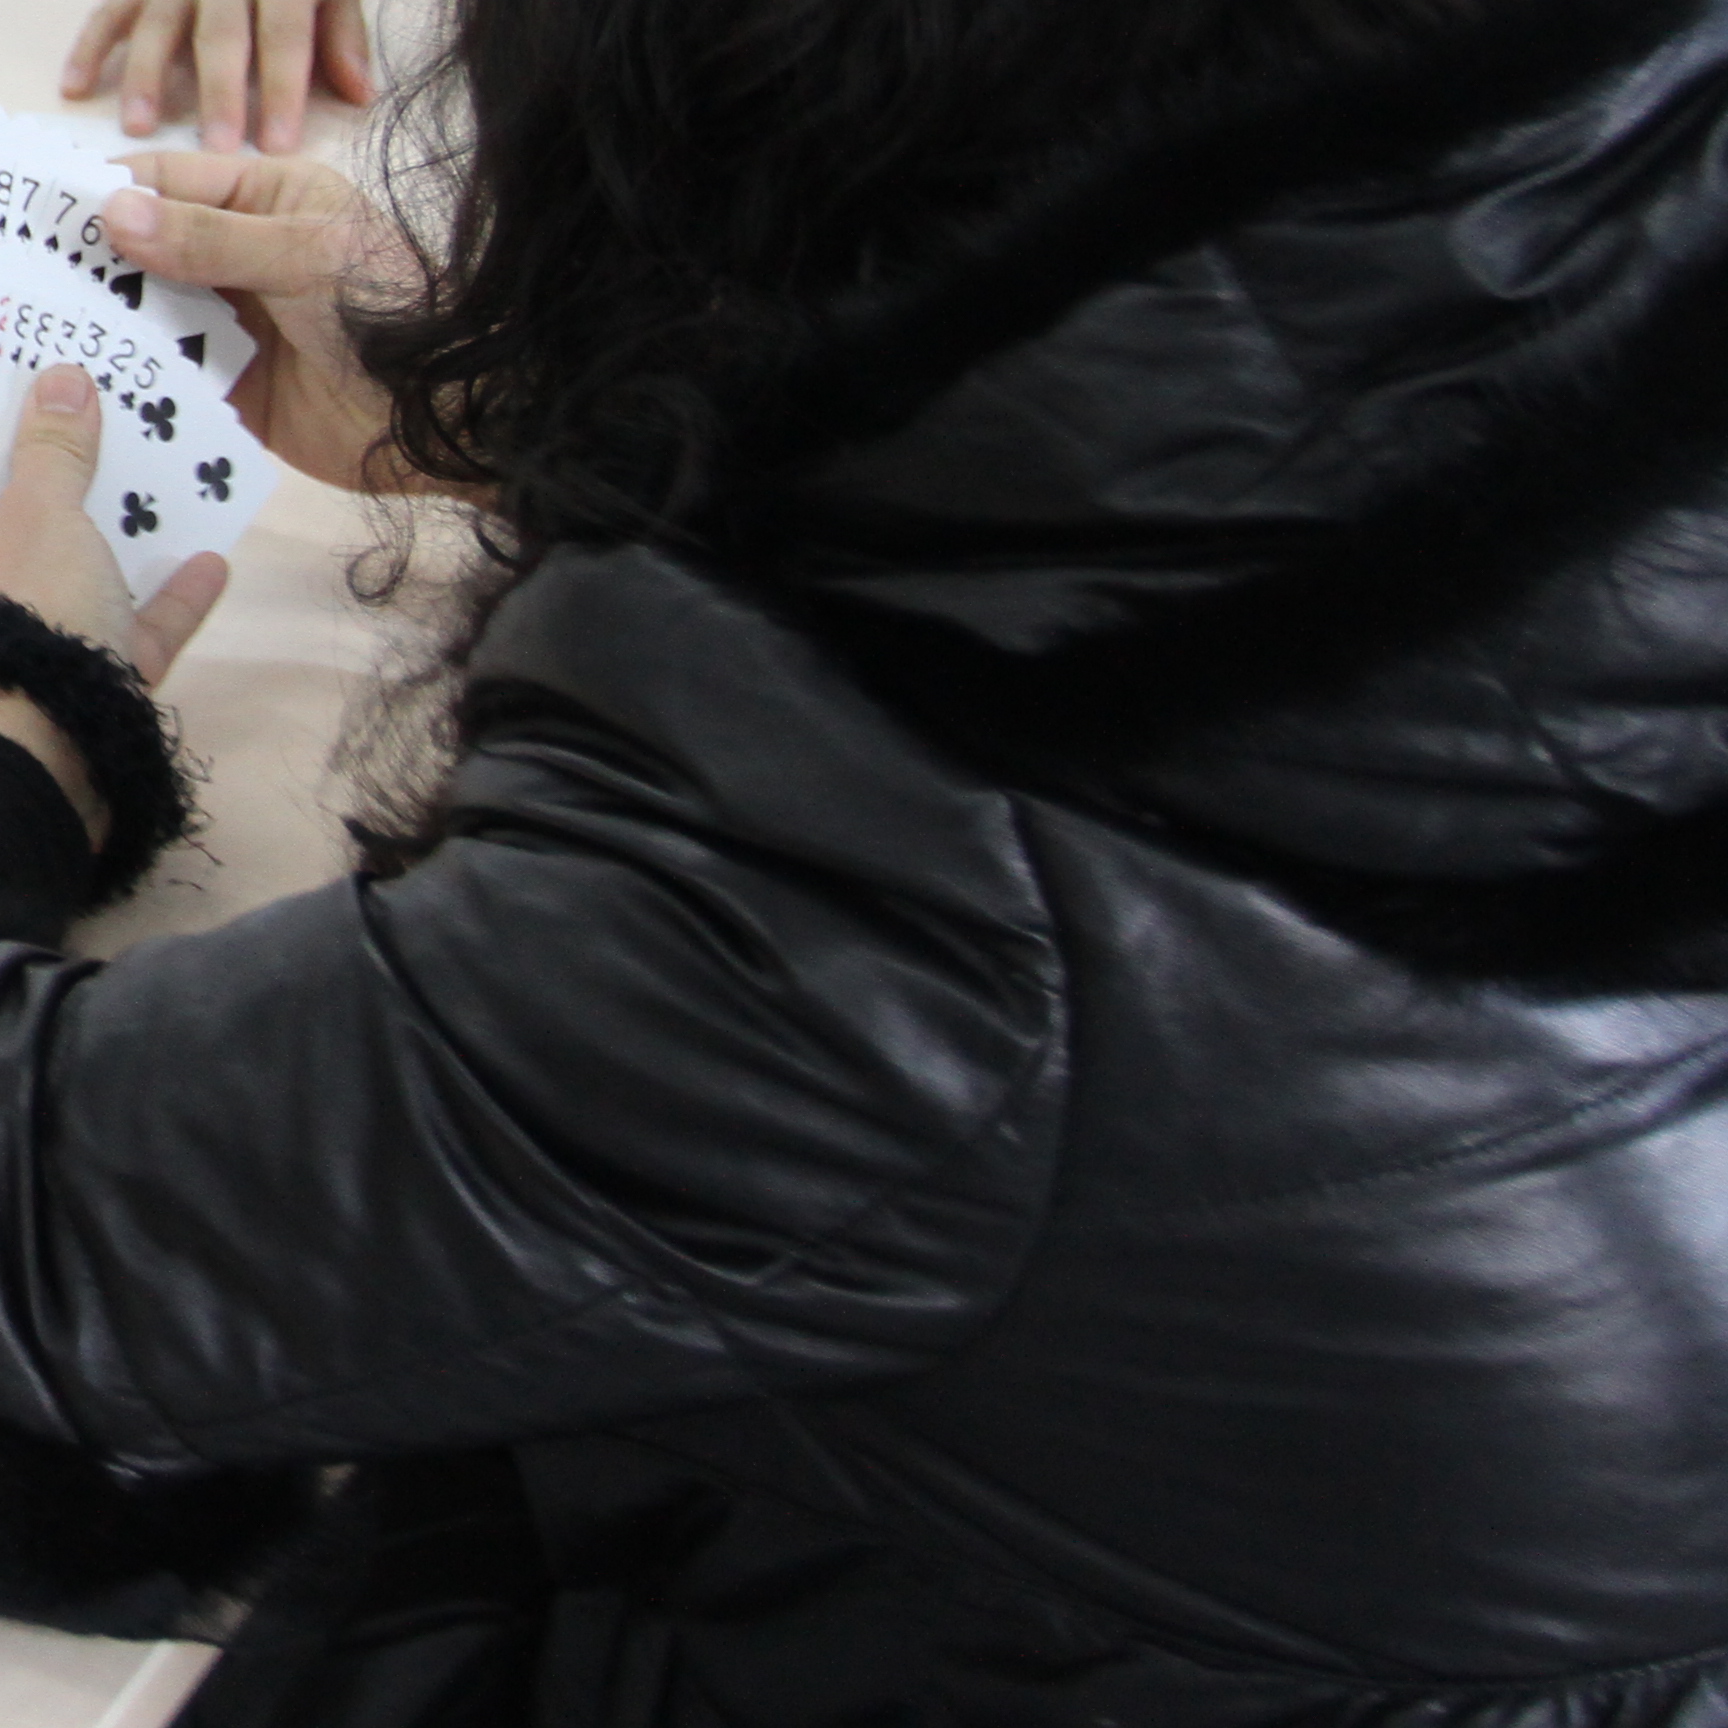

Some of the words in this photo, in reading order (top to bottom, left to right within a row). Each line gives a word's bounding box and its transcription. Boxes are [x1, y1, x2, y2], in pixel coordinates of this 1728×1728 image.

[22, 176, 40, 212] 7
[59, 190, 78, 224] 7
[81, 215, 107, 245] 6
[79, 321, 107, 358] 3
[108, 339, 135, 373] 2
[134, 356, 163, 390] 5
